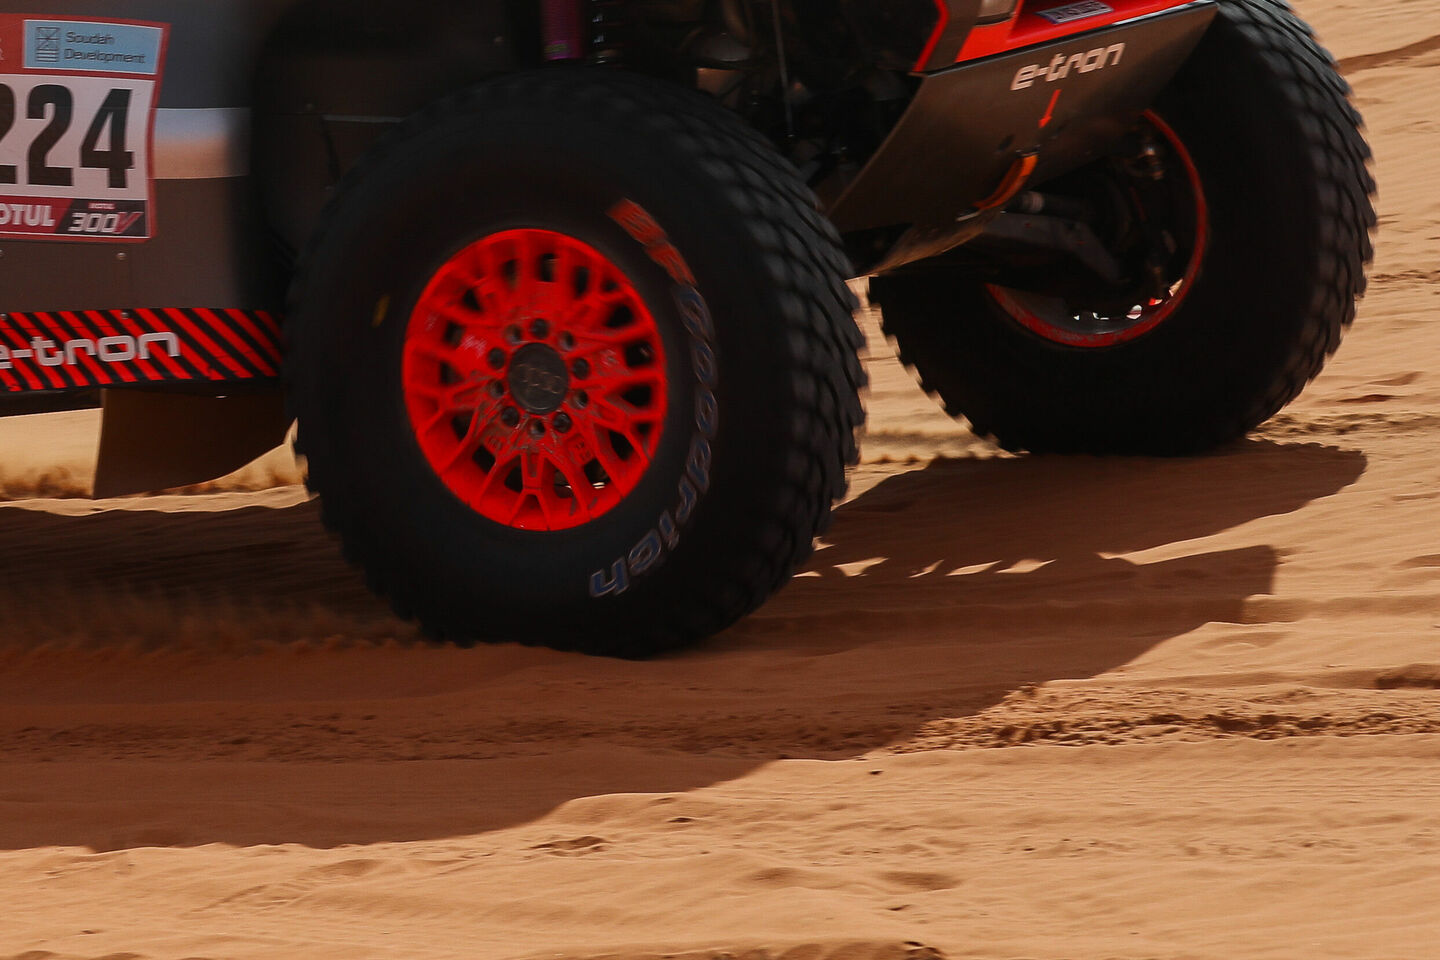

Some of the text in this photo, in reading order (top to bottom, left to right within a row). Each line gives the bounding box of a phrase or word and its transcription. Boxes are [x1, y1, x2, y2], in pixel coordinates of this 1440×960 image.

[66, 31, 115, 45] Soudah
[64, 48, 146, 63] Development
[1010, 43, 1126, 91] e-tron
[68, 212, 145, 235] 300V
